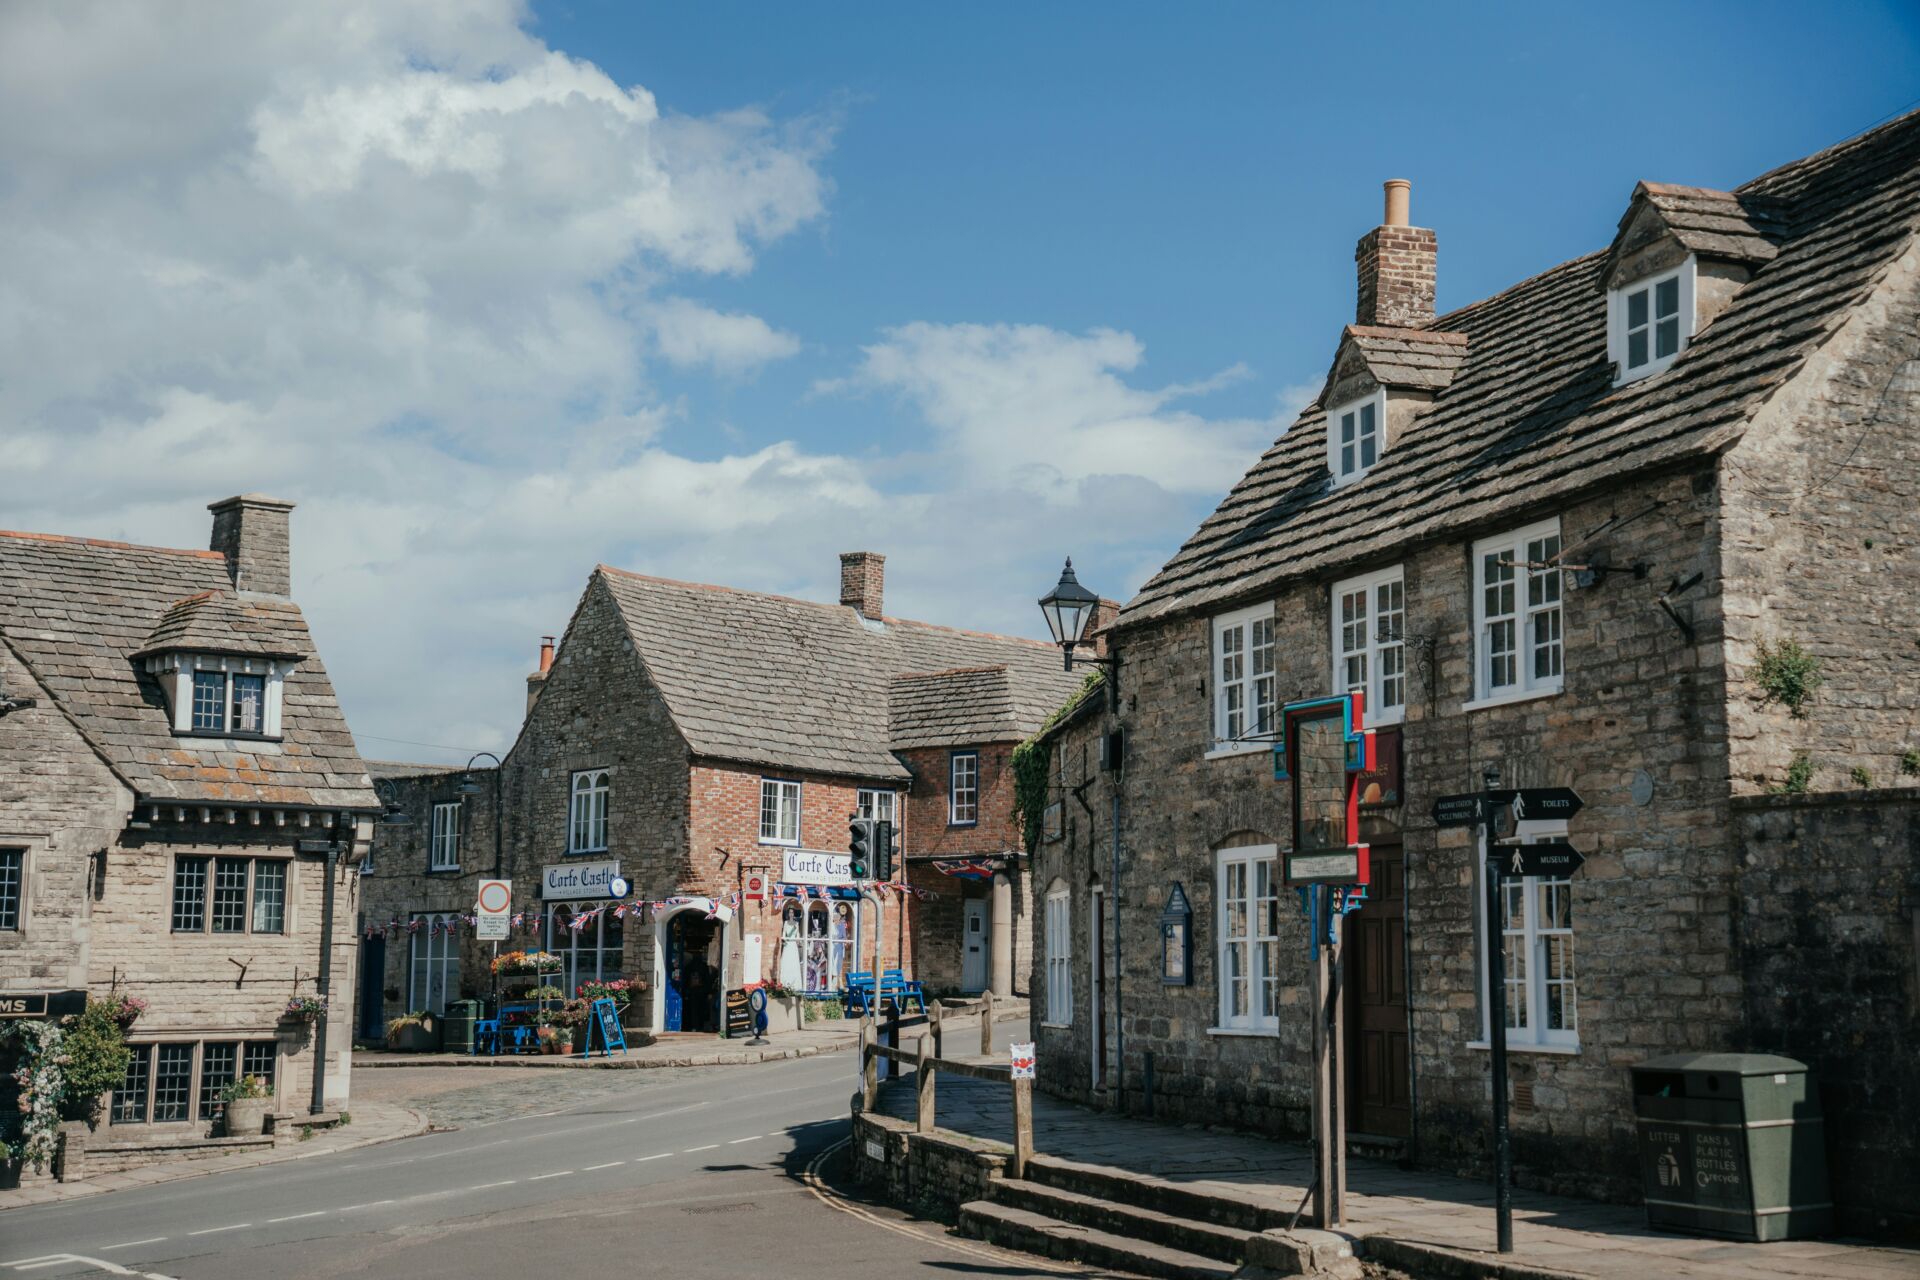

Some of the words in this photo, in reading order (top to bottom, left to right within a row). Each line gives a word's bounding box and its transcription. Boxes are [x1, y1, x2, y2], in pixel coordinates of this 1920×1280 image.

[1542, 799, 1570, 808] TOILETS
[788, 852, 822, 873] Corfe
[825, 855, 849, 875] Cas
[1540, 855, 1570, 864] MUSEUM
[548, 868, 578, 888] Corfe
[0, 999, 27, 1012] MS
[1648, 1131, 1681, 1143] LITTER
[1696, 1134, 1721, 1145] CANS
[1723, 1136, 1730, 1146] &
[1696, 1146, 1733, 1158] PLASTIC
[1696, 1158, 1737, 1171] BOTTLES
[1709, 1172, 1740, 1184] recycle
